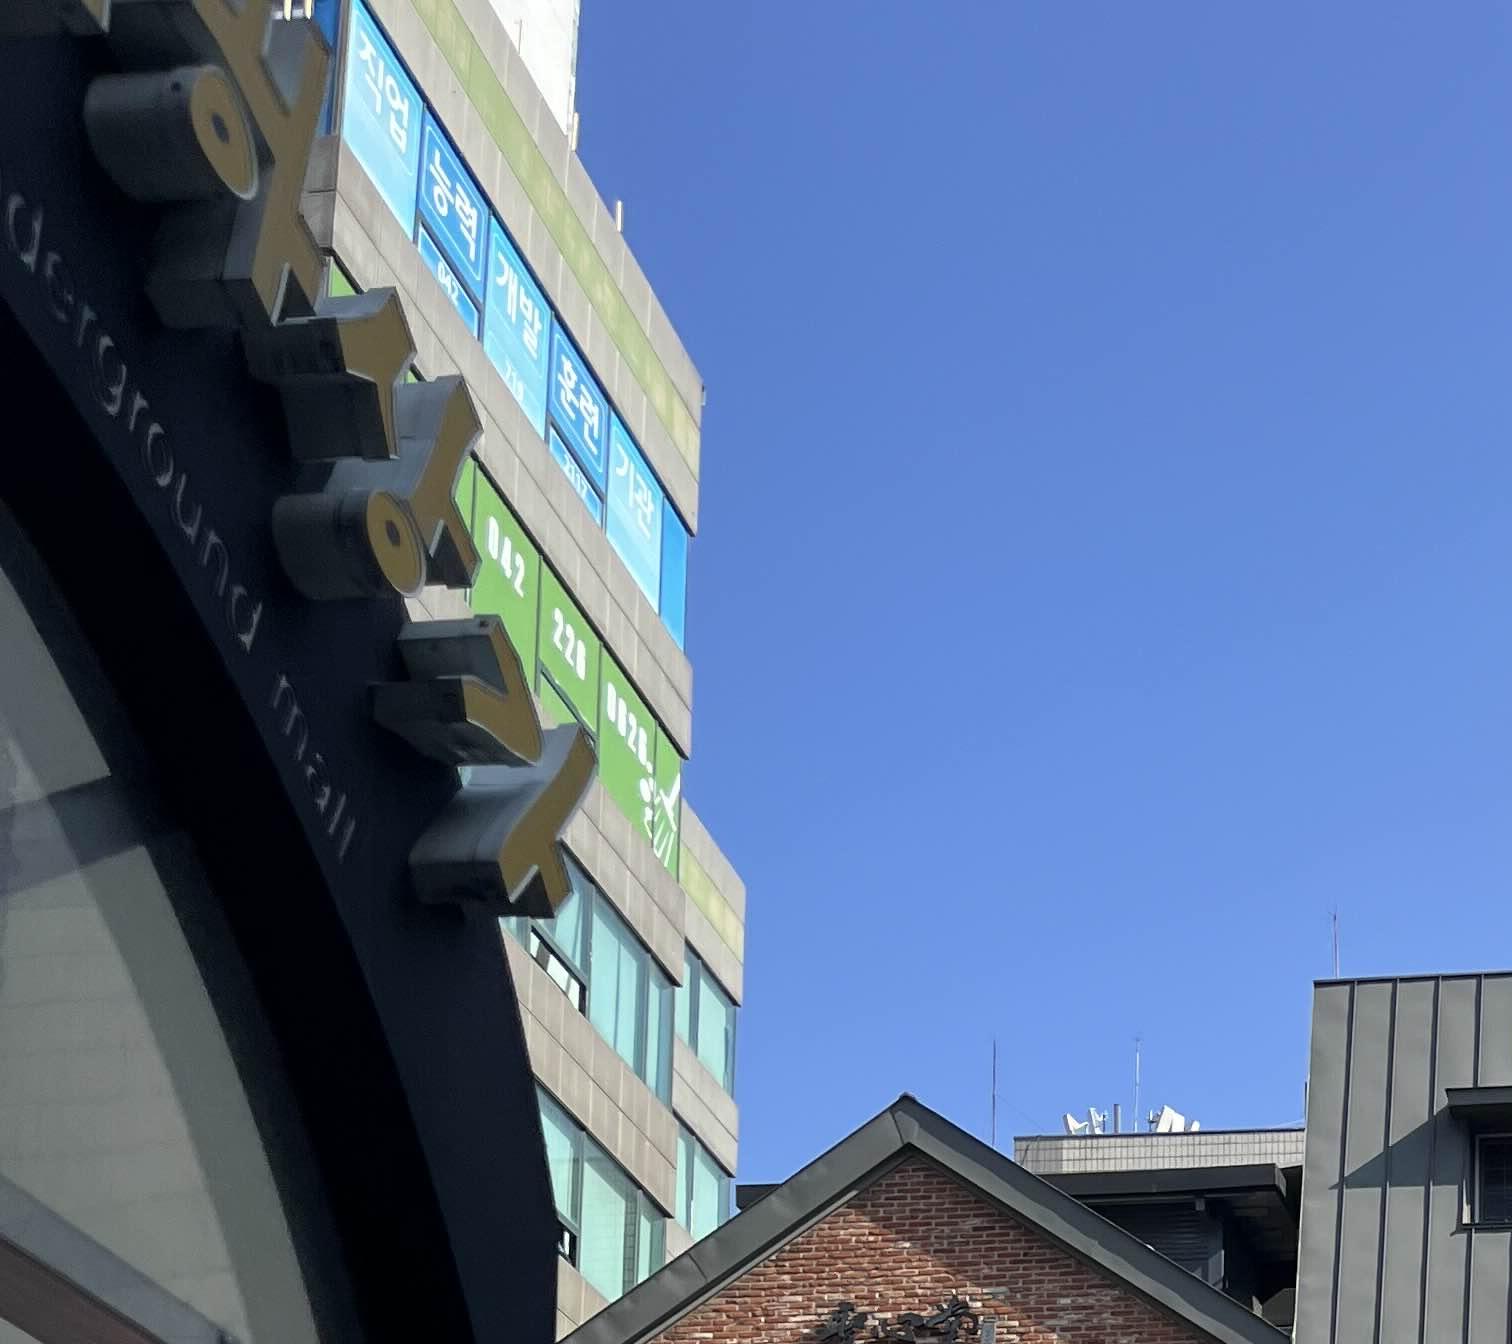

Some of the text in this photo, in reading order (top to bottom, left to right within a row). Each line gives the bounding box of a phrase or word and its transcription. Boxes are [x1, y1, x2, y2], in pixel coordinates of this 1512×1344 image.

[428, 147, 480, 263] 능력
[494, 249, 543, 361] 개발
[557, 353, 601, 456] 훈련
[270, 670, 358, 865] mall
